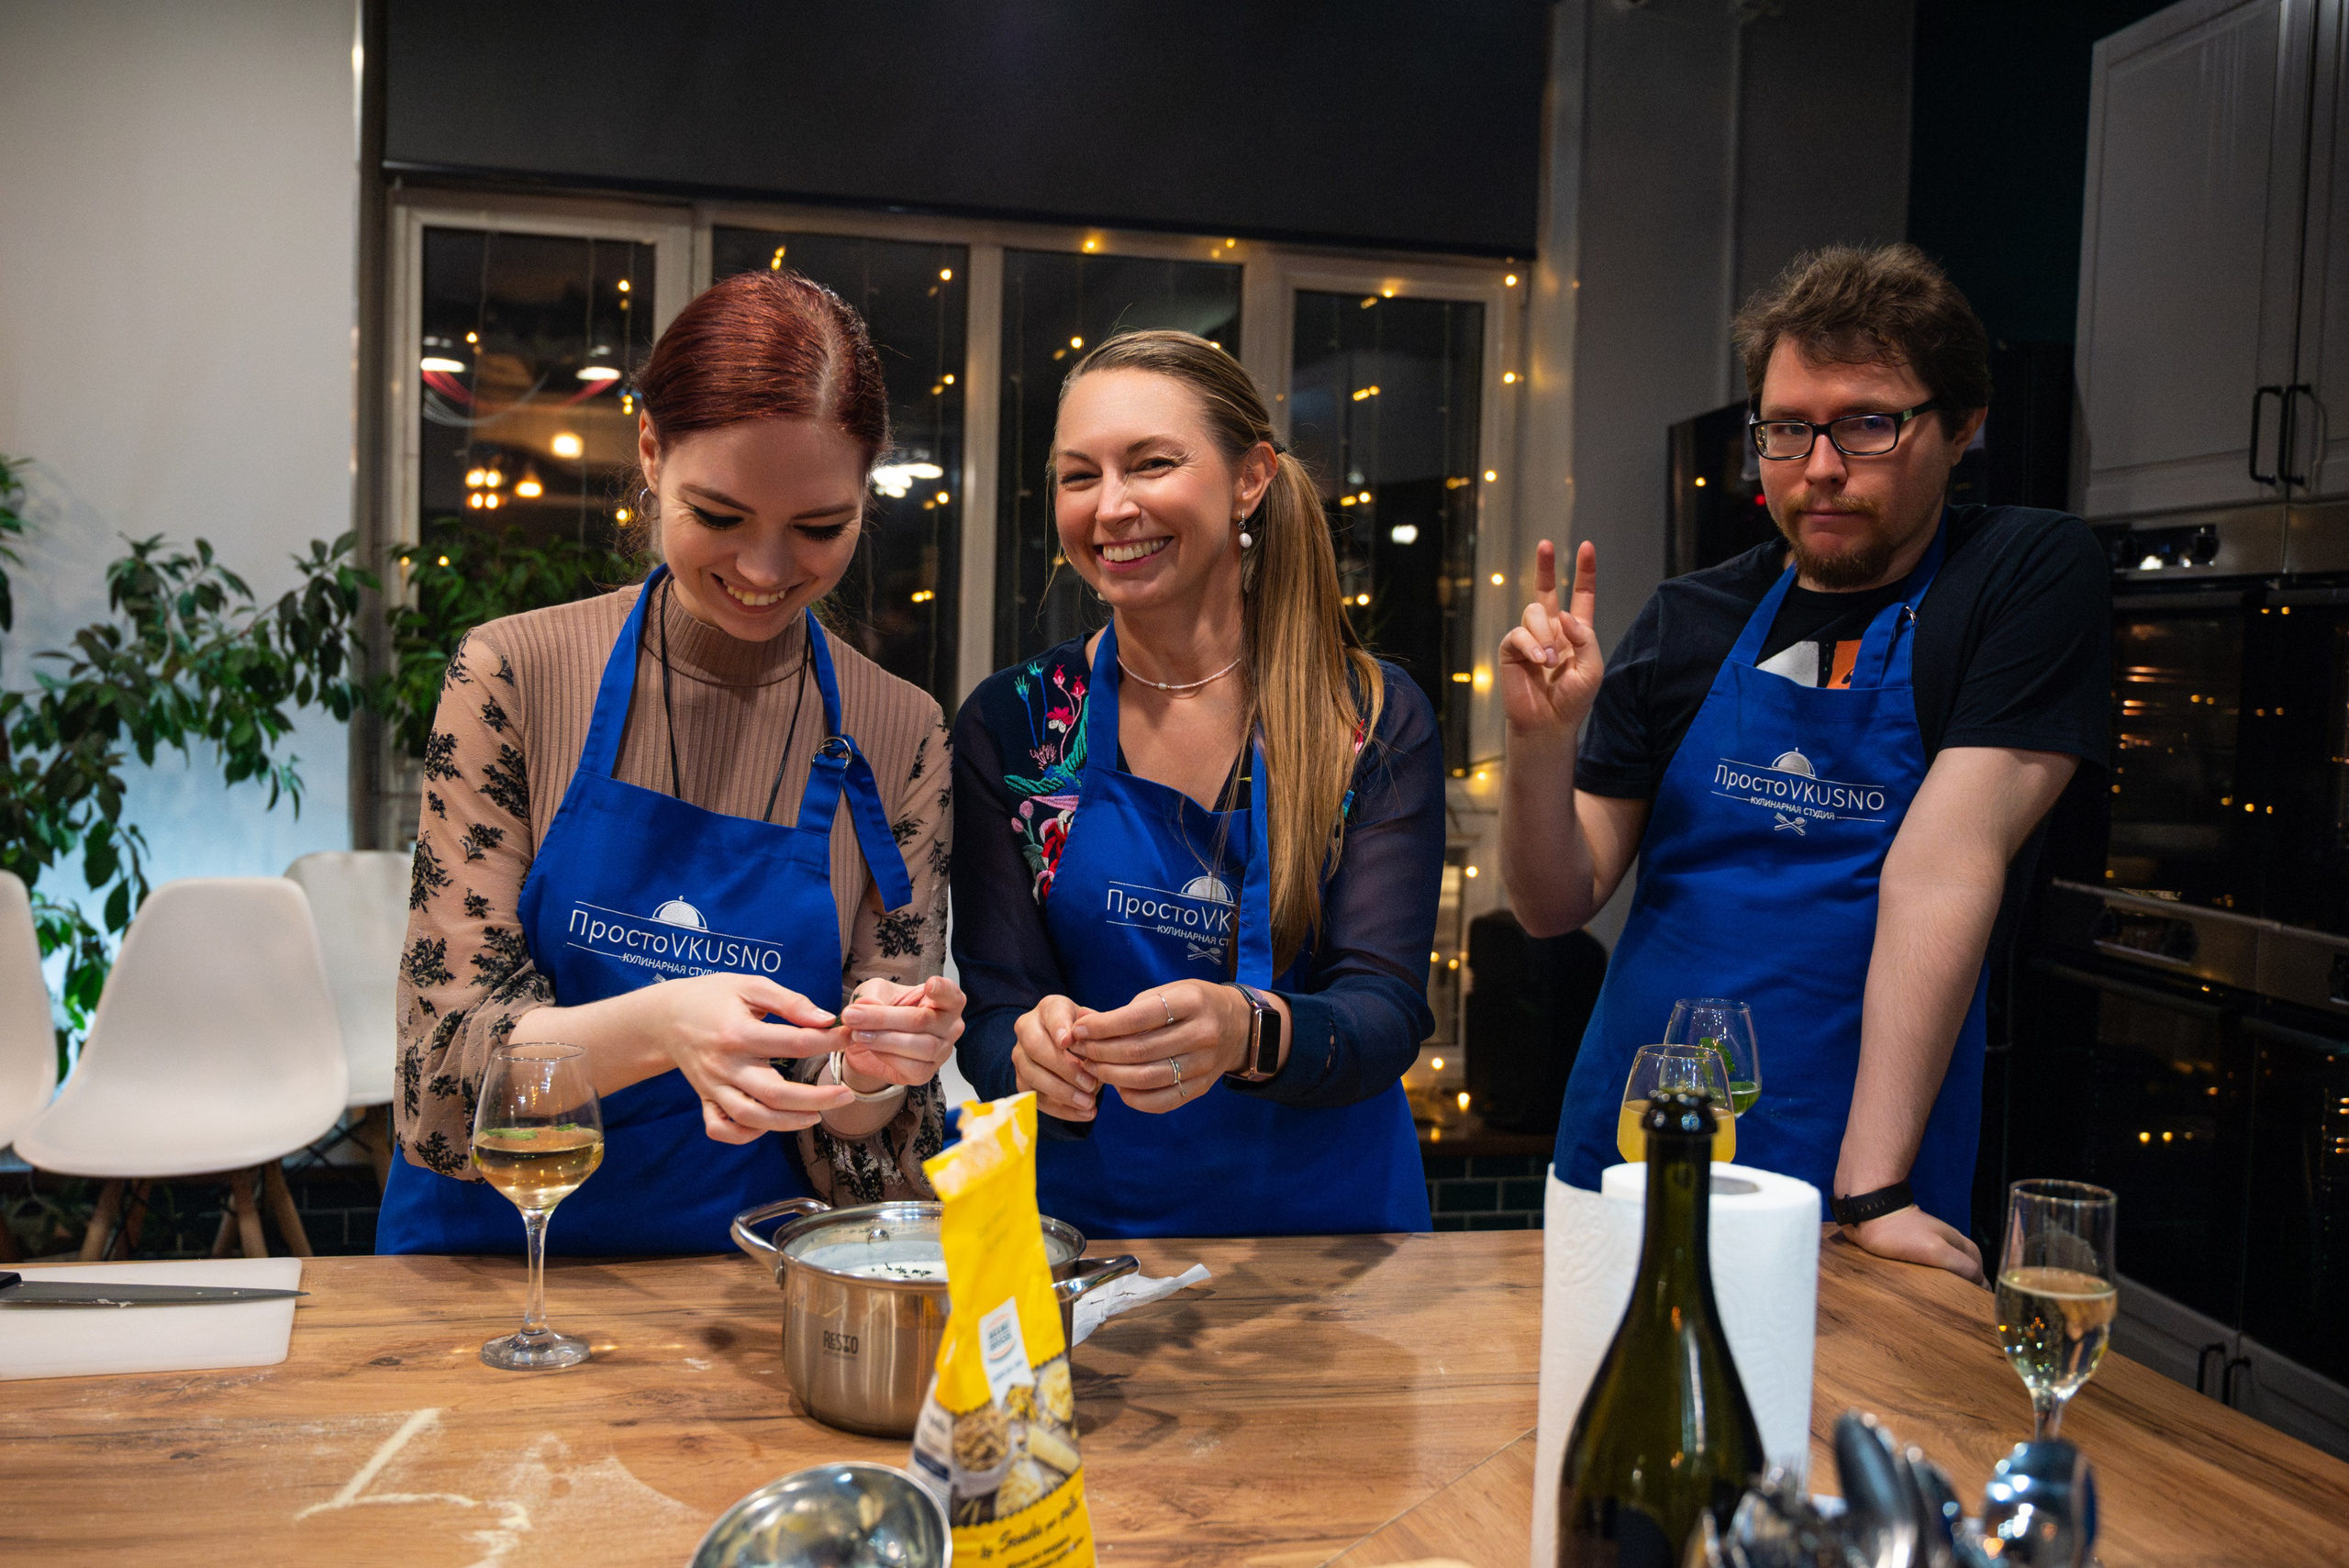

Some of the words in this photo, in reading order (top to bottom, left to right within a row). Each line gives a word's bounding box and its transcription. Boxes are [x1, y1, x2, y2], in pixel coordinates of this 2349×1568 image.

[1714, 764, 1885, 811] ПростоVKUSNO
[1750, 795, 1802, 814] КУЛИНАРНАЯ
[1803, 807, 1835, 820] СТУДИЯ
[1107, 888, 1232, 932] ПростоVK
[569, 909, 782, 973] ПростоVKUSNO
[1156, 924, 1217, 945] КУЛИНАРНАЯ
[622, 952, 686, 975] КУЛИНАРНАЯ
[823, 1329, 860, 1354] RESTO
